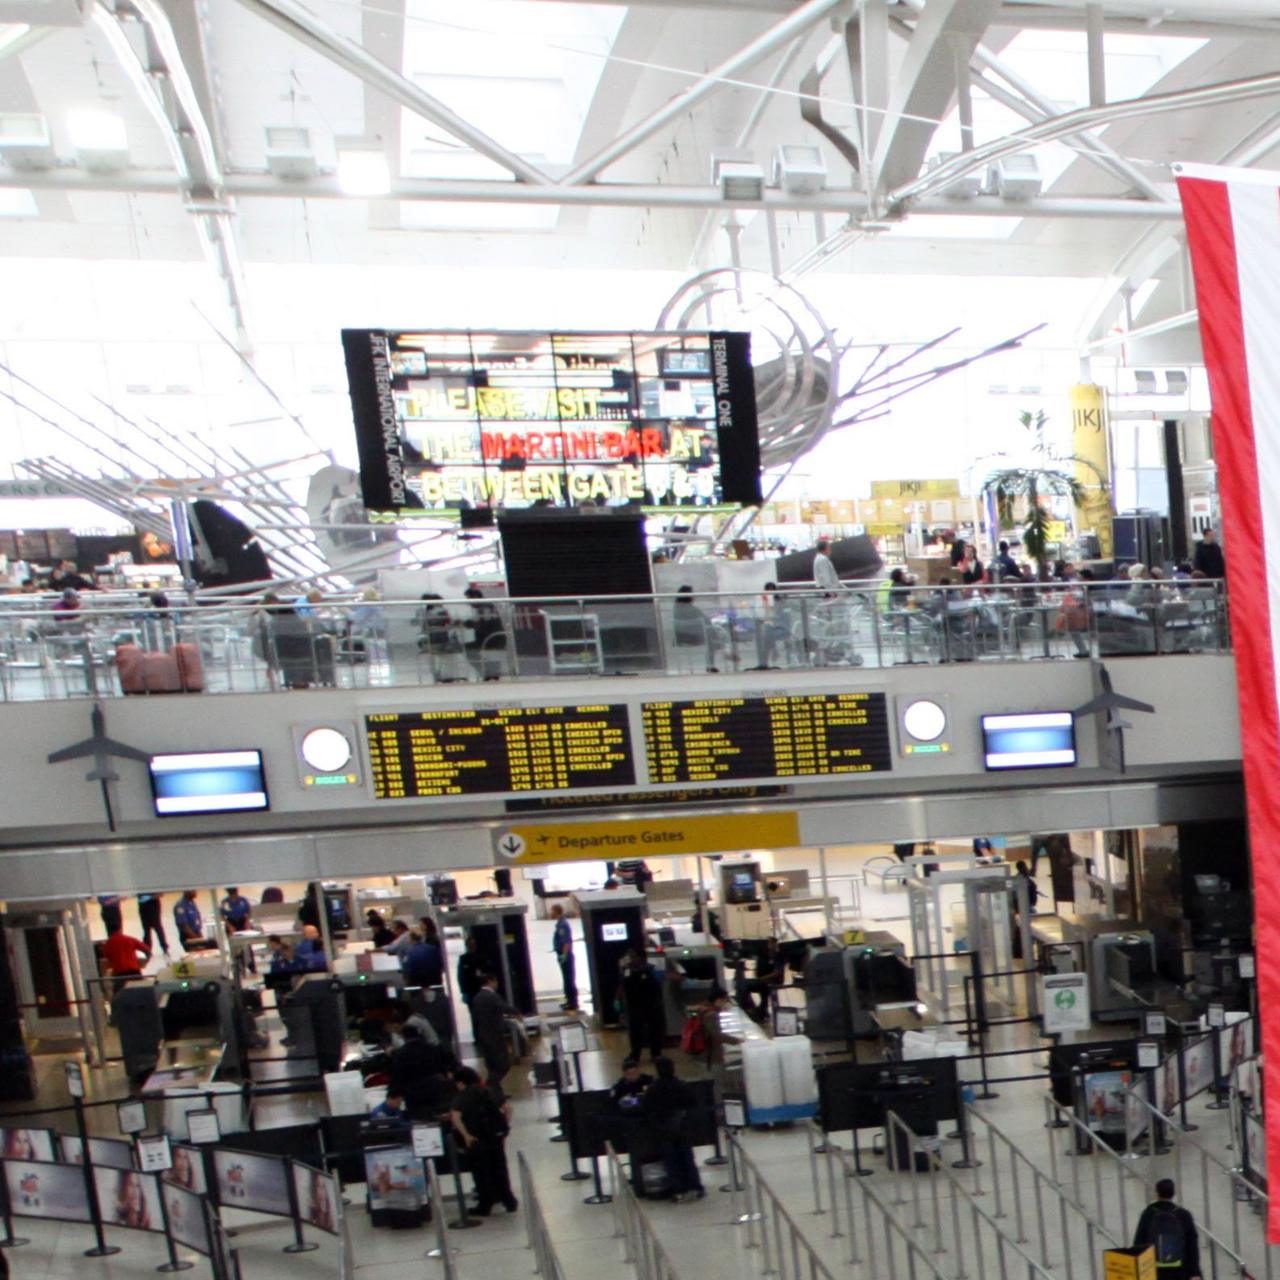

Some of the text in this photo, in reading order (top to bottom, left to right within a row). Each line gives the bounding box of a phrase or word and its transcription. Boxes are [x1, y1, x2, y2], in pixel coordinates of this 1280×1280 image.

[713, 338, 732, 427] TERMINAL ONE
[373, 355, 398, 450] INTERNATIONAL
[411, 387, 522, 417] PLEASE
[420, 428, 704, 460] THE MARTINI BAR AT
[385, 452, 406, 504] AIRPORT
[421, 469, 564, 502] BETWEEN
[567, 466, 645, 500] GATE
[565, 720, 607, 730] CANCELLED
[602, 728, 623, 737] OPEN
[568, 746, 611, 755] CANCELLED
[603, 736, 623, 745] OPEN
[570, 761, 613, 771] CANCELLED
[605, 753, 626, 762] OPEN
[558, 830, 685, 850] Departure Gates
